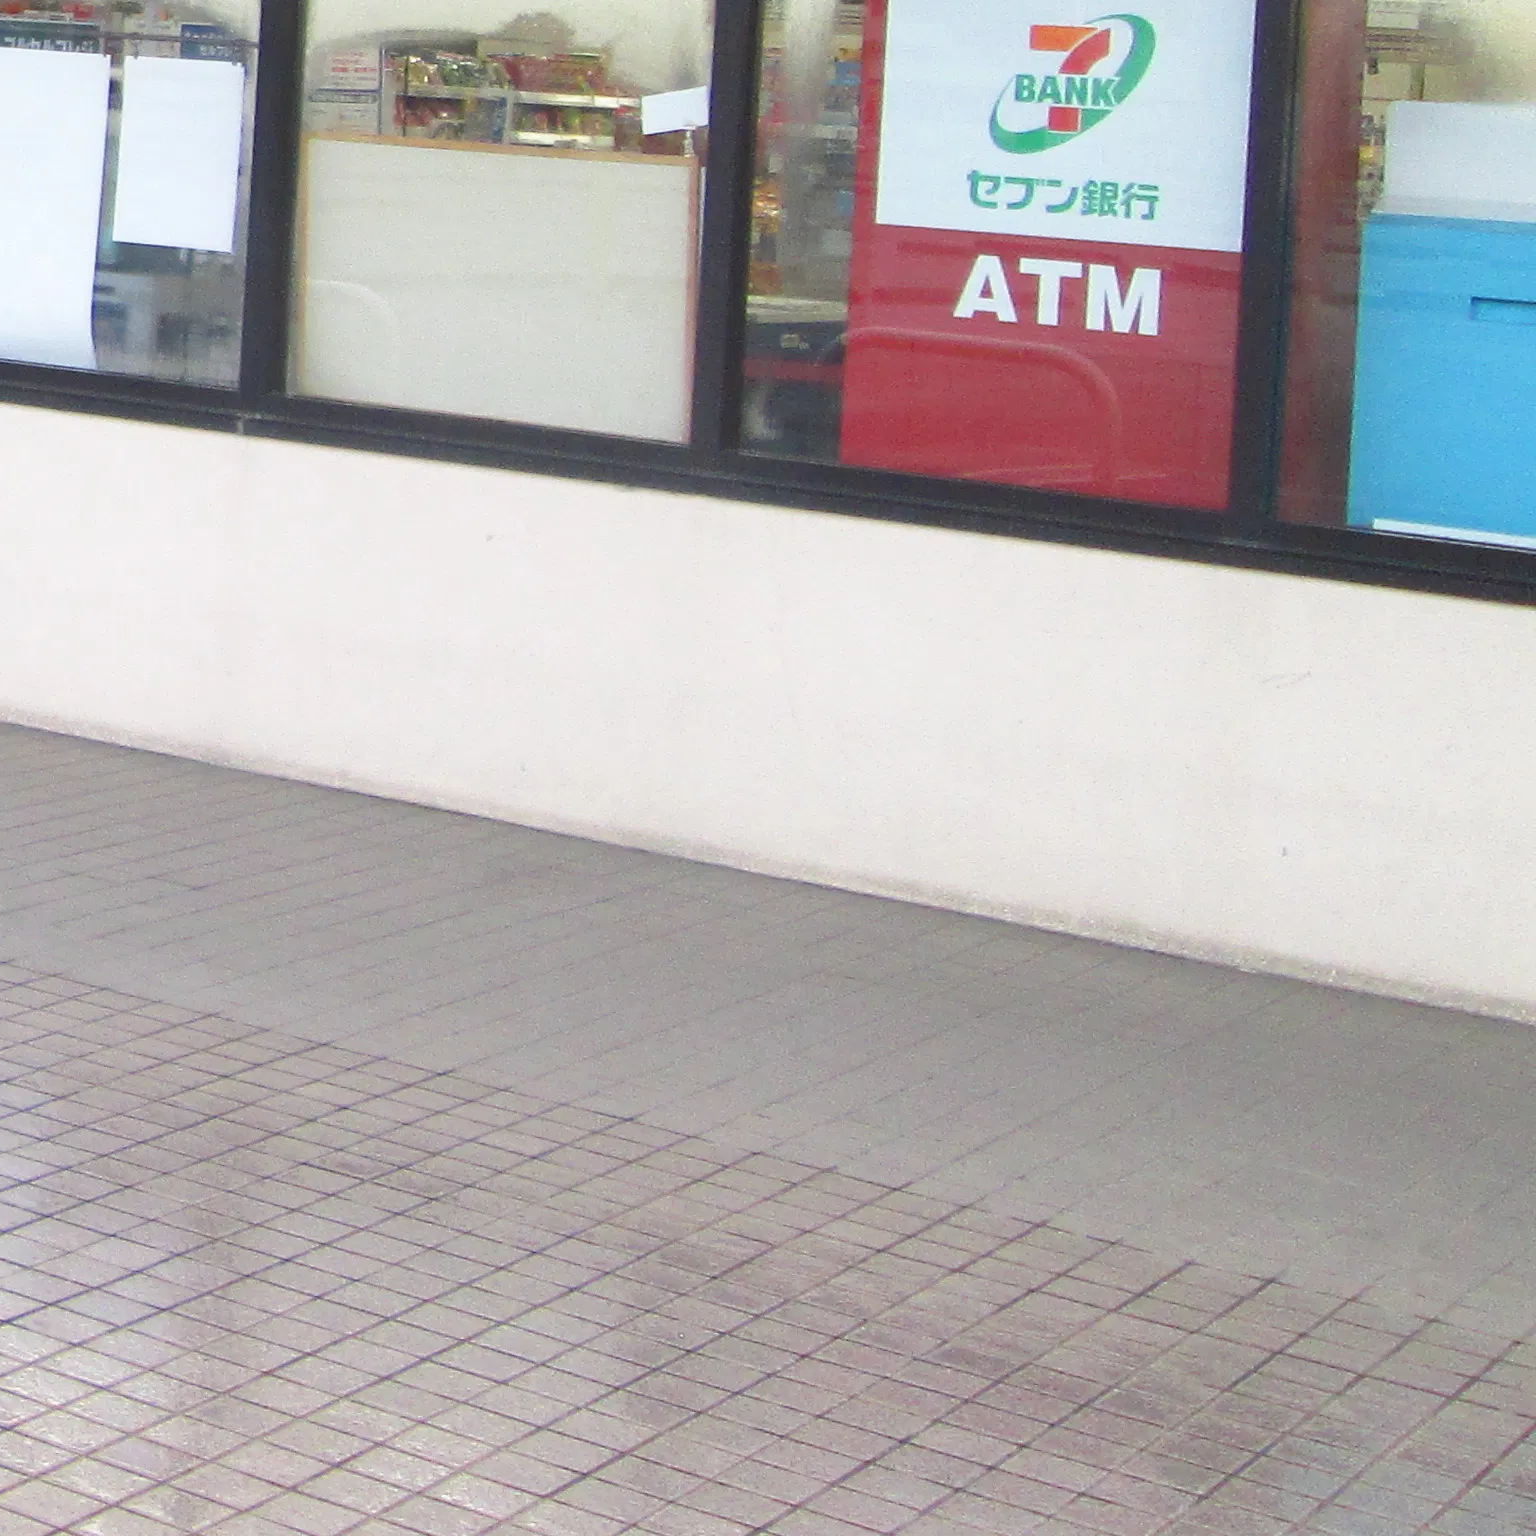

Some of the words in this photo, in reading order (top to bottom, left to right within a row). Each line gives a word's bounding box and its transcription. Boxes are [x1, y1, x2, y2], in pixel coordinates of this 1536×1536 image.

[1015, 74, 1117, 107] BANK
[966, 170, 1160, 221] セブン銀行
[952, 254, 1162, 336] ATM
